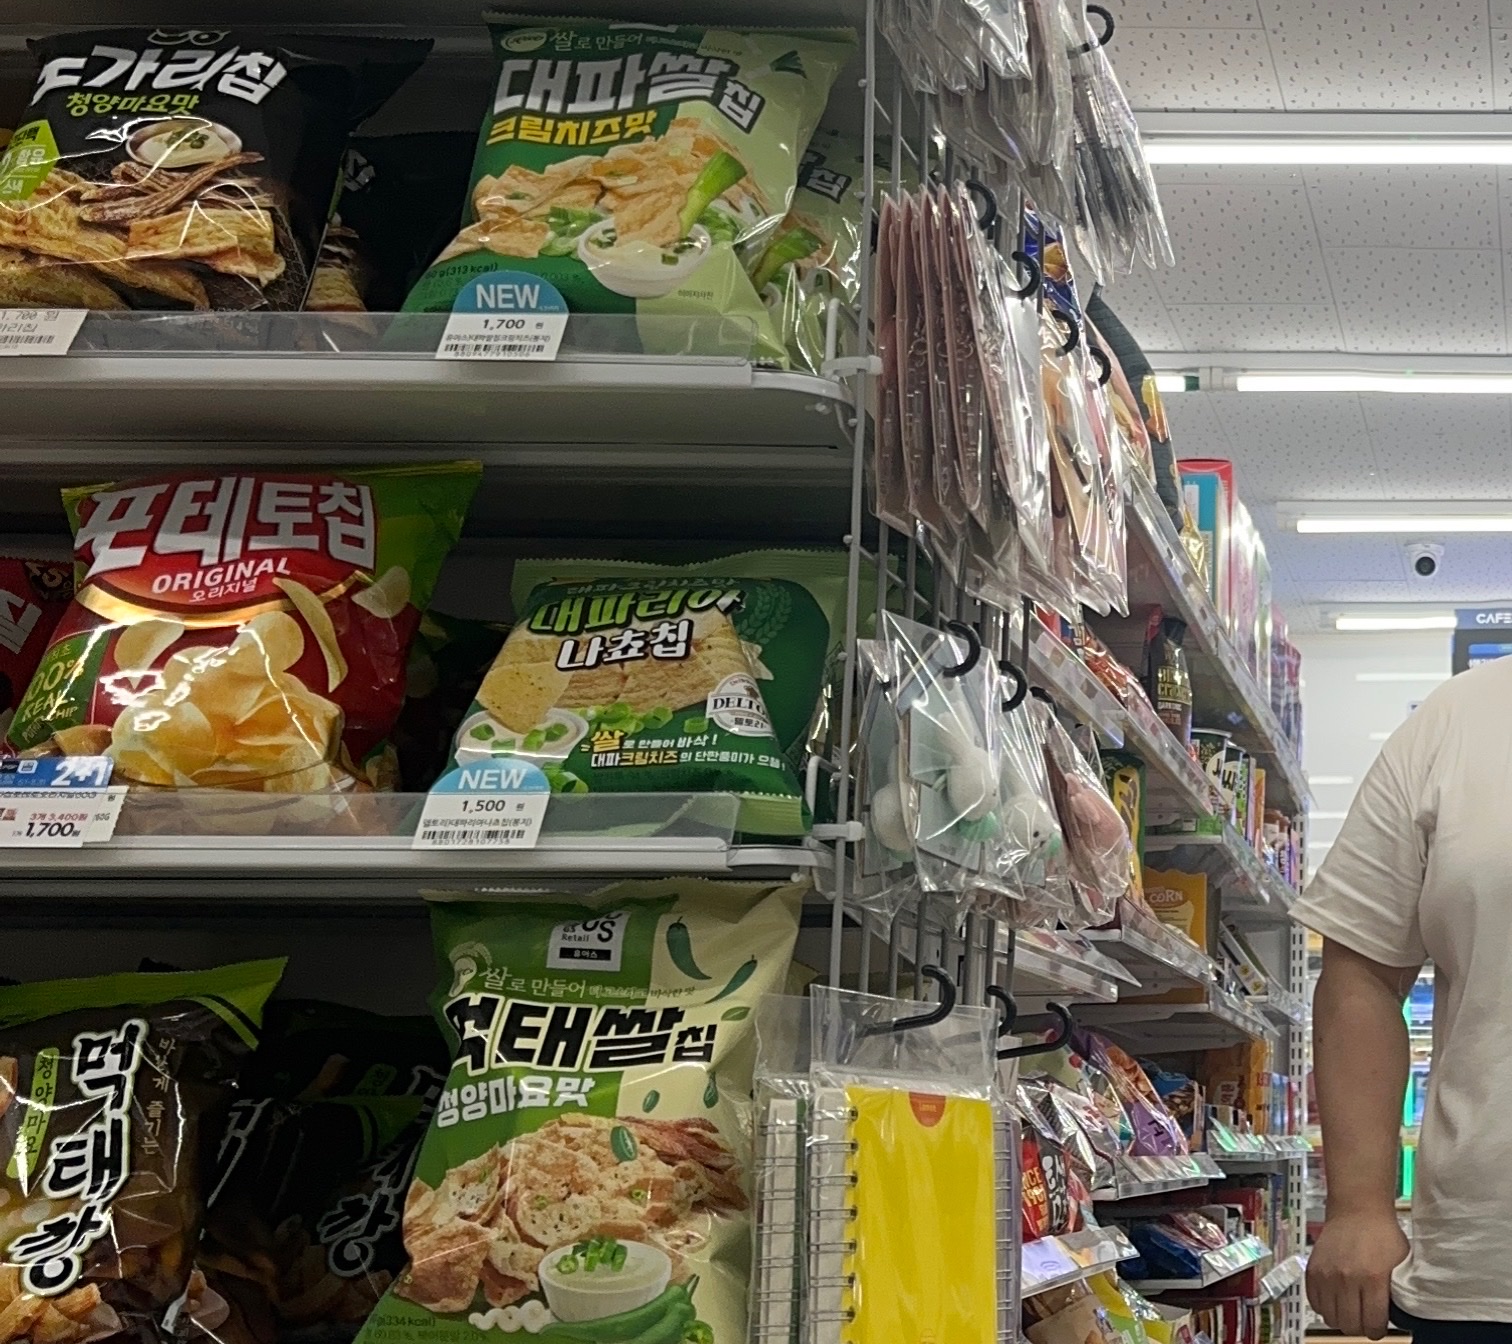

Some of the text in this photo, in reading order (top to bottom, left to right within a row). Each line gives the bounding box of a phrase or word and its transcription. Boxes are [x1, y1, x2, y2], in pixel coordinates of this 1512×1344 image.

[67, 92, 200, 117] 청양마요맛
[486, 110, 657, 146] 크림치즈맛
[476, 285, 541, 308] NEW
[482, 319, 525, 331] 1,700
[152, 557, 291, 595] ORIGINAL
[189, 576, 258, 603] 오리지널
[555, 620, 694, 671] 나쵸칩
[592, 730, 634, 751] 쌀로
[458, 768, 526, 790] NEW
[462, 800, 505, 813] 1,500
[1149, 890, 1184, 905] CORN
[480, 965, 585, 999] 쌀로 만들어
[437, 1073, 595, 1128] 청양마요맛
[8, 1019, 148, 1296] 먹태깡
